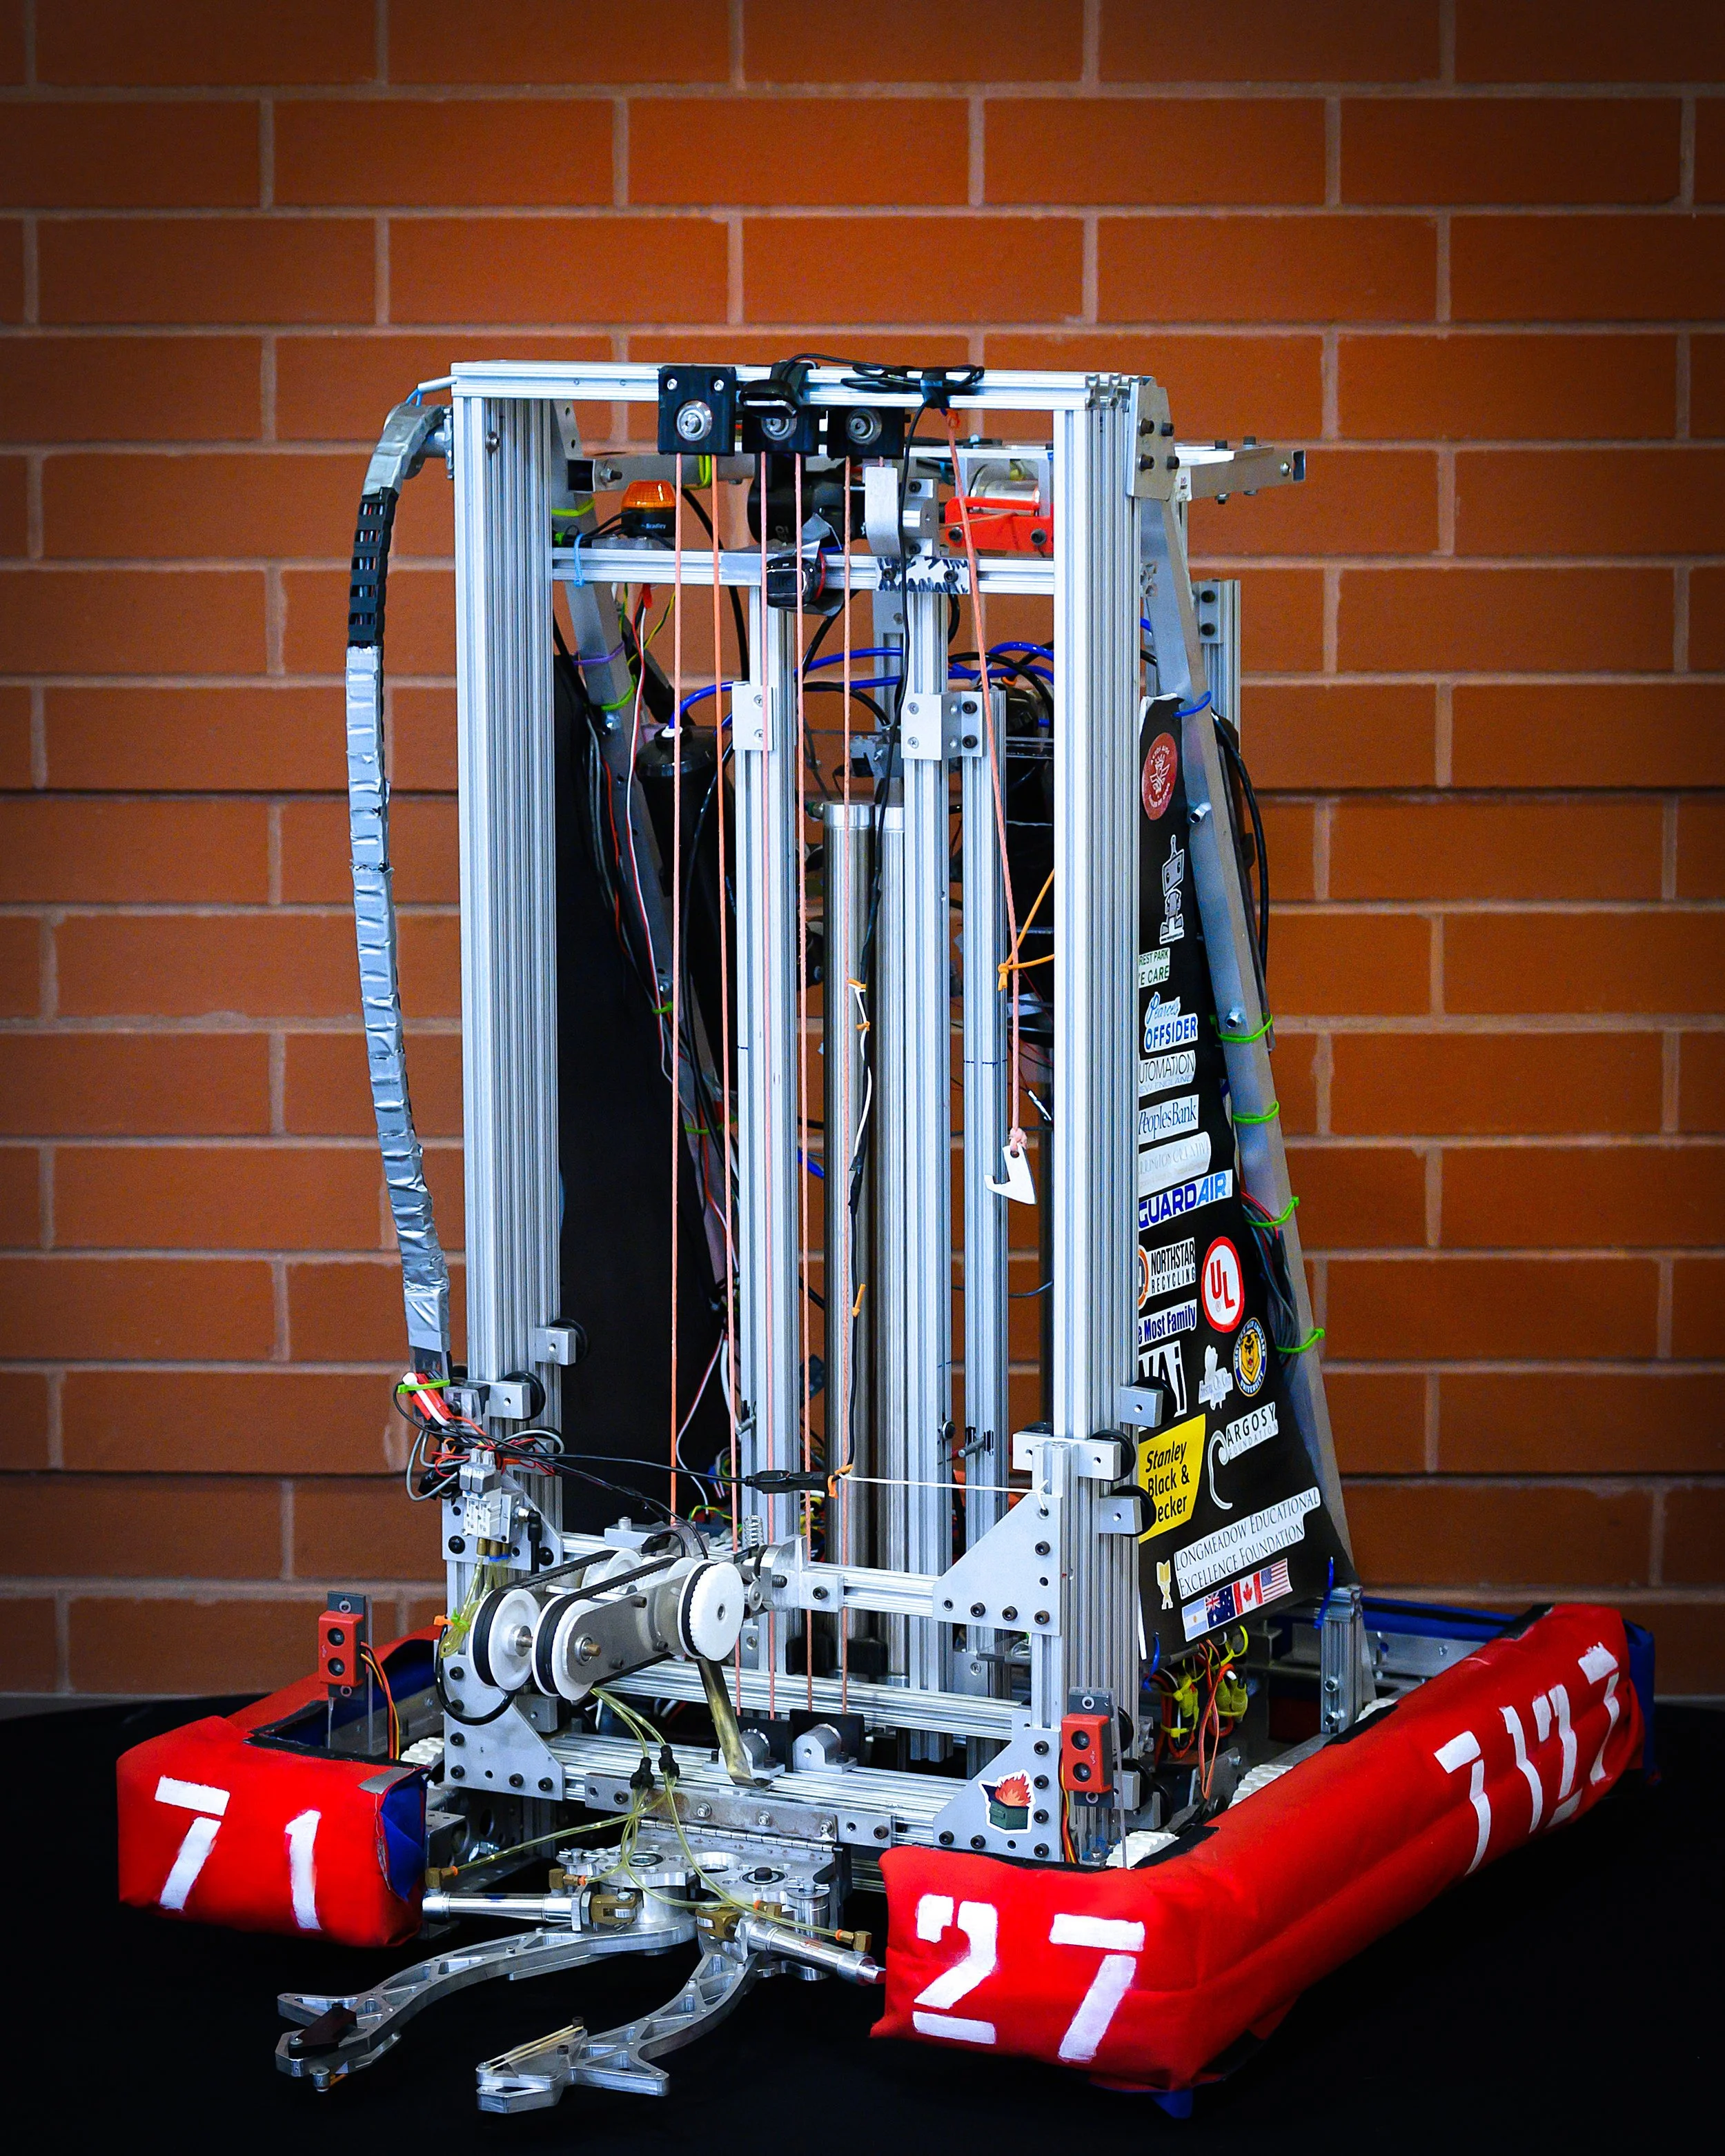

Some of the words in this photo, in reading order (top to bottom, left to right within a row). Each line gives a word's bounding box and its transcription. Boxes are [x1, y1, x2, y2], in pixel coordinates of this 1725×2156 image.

[1139, 953, 1152, 965] REST
[1147, 965, 1169, 983] CARE
[1145, 1016, 1196, 1049] OFFSIDER
[1139, 1052, 1194, 1083] UTOMATION
[1138, 1098, 1196, 1139] PeoplesBank
[1138, 1172, 1226, 1229] GUARDAIR
[1151, 1241, 1195, 1276] NORTHSTAR
[1152, 1267, 1196, 1294] RECYCLING
[1210, 1259, 1235, 1309] UL
[1144, 1315, 1165, 1342] Most
[1167, 1305, 1195, 1334] Family
[1228, 1404, 1274, 1447] ARGOSY
[1145, 1441, 1187, 1472] Stanley
[1148, 1468, 1177, 1499] Black
[1181, 1464, 1190, 1485] &
[1158, 1495, 1187, 1522] ecker
[1175, 1521, 1248, 1571] LONGMEADOW
[1250, 1490, 1319, 1534] EDUCATIONAL
[1178, 1555, 1239, 1596] EXCELLENCE
[1239, 1521, 1304, 1567] FOUNDATION
